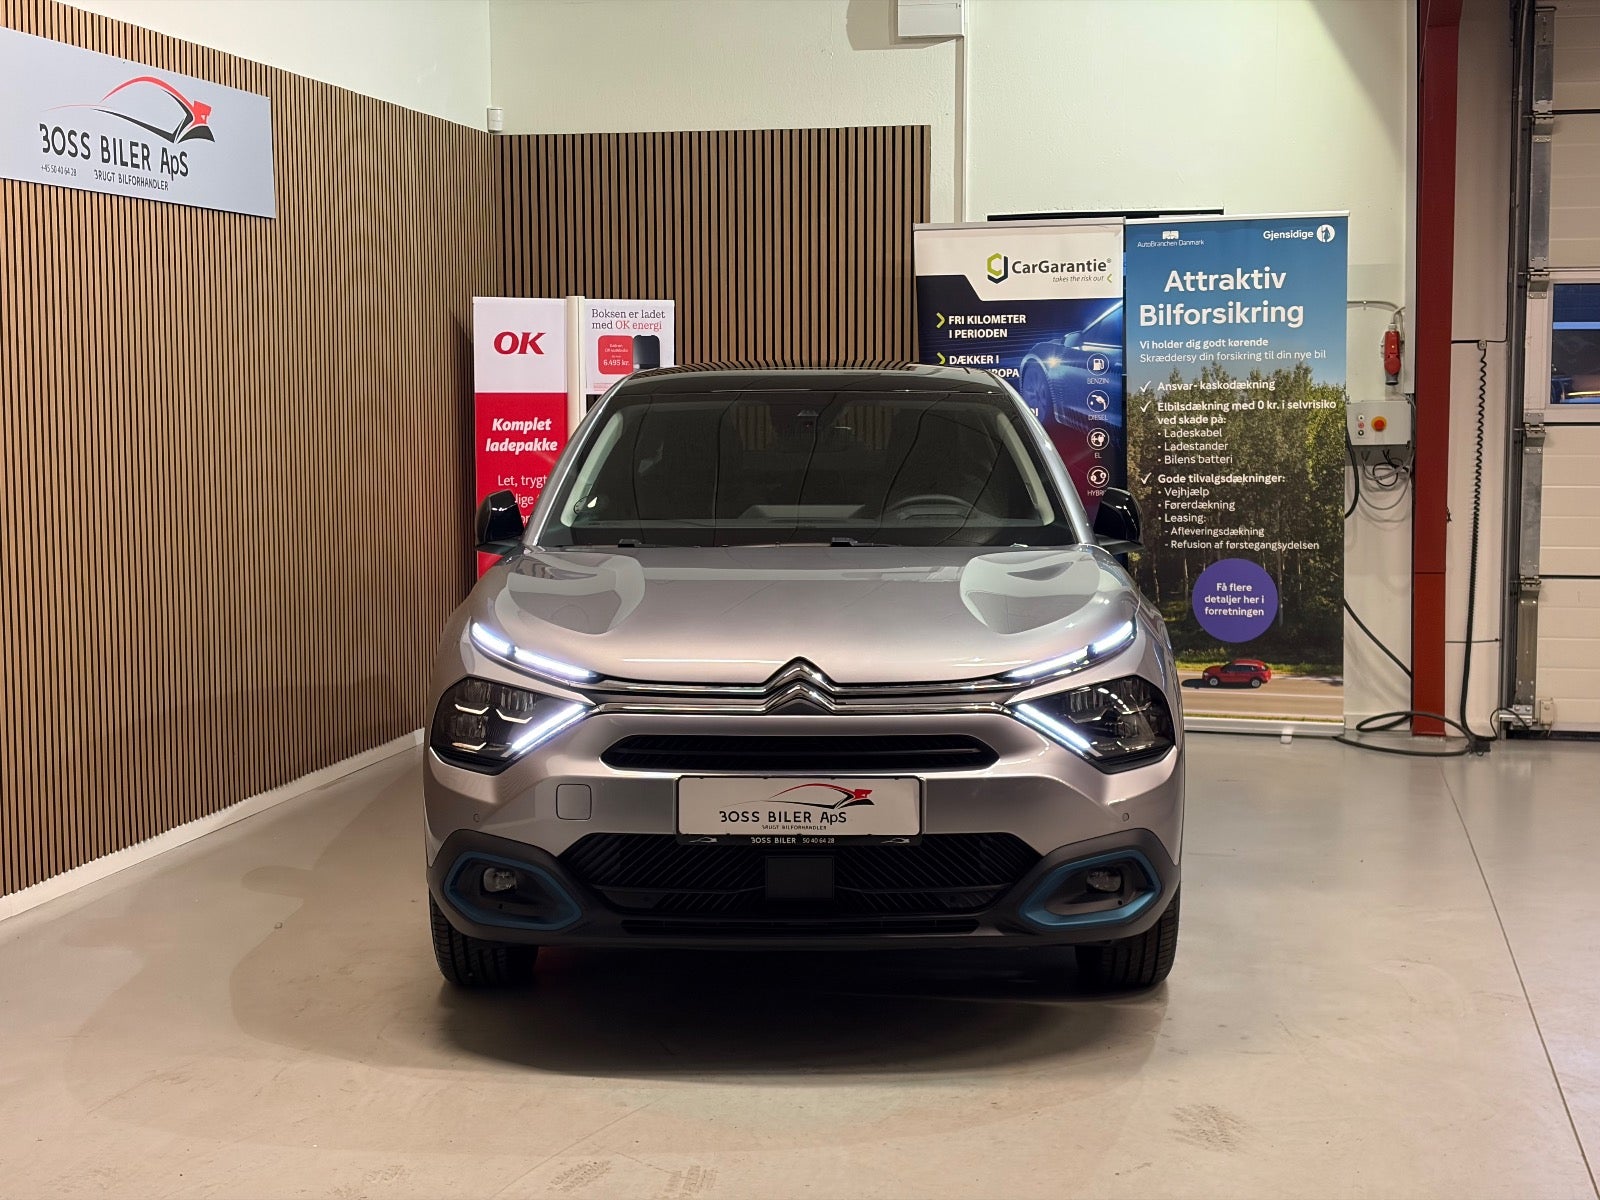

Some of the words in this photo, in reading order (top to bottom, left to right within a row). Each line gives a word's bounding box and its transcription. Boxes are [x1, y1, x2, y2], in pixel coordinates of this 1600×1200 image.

[100, 135, 152, 171] BILER
[160, 146, 189, 181] ApS
[118, 173, 169, 191] BILFORHANDLER
[1263, 229, 1314, 240] Gjensidige
[1164, 266, 1287, 292] Attraktiv
[592, 308, 626, 318] Boksen
[641, 310, 665, 319] ladet
[1140, 300, 1304, 328] Bilforsikring
[592, 320, 613, 329] med
[615, 321, 630, 329] OK
[632, 321, 662, 331] energi
[948, 315, 965, 326] FRI
[967, 314, 1026, 325] KILOMETER
[949, 330, 952, 338] I
[954, 328, 1008, 338] PERIODEN
[493, 331, 547, 355] OK
[1140, 340, 1149, 349] Vi
[1152, 339, 1183, 349] holder
[1185, 338, 1200, 351] dig
[1203, 338, 1226, 351] godt
[1228, 337, 1268, 347] kørende
[949, 355, 993, 365] DÆKKER
[996, 354, 999, 364] I
[1140, 353, 1196, 364] Skræddersy
[1199, 352, 1214, 361] din
[1216, 351, 1262, 363] forsikring
[1264, 351, 1274, 360] til
[1276, 350, 1292, 360] din
[1294, 352, 1312, 362] nye
[1314, 350, 1326, 359] bil
[1158, 382, 1198, 391] Ansvar-
[1200, 380, 1276, 391] kaskodækning
[1158, 401, 1230, 413] Elbilsdækning
[1232, 401, 1255, 410] med
[1257, 401, 1265, 410] 0
[1267, 401, 1280, 410] kr.
[1282, 401, 1286, 409] i
[1287, 400, 1336, 409] selvrisiko
[492, 416, 552, 434] Komplet
[1158, 416, 1176, 425] ved
[1178, 416, 1208, 425] skade
[1210, 414, 1227, 426] på:
[1164, 429, 1222, 438] Ladeskabel
[485, 438, 558, 455] ladepakke
[1164, 442, 1228, 451] Ladestander
[1164, 455, 1196, 464] Bilens
[1198, 455, 1233, 464] batteri
[498, 475, 518, 487] Let,
[521, 475, 547, 488] trygt
[1158, 474, 1186, 483] Gode
[1188, 474, 1286, 485] tilvalgsdækninger:
[1164, 488, 1209, 497] Vejhjælp
[1164, 500, 1235, 512] Førerdækning
[1164, 514, 1206, 524] Leasing:
[1170, 527, 1264, 537] Afleveringsdækning
[1171, 540, 1211, 549] Refusion
[1214, 541, 1223, 549] af
[1225, 541, 1319, 551] førstegangsydelsen
[1216, 582, 1227, 592] Få
[1230, 583, 1252, 591] flere
[1204, 595, 1242, 606] detaljer
[1243, 595, 1260, 604] her
[1262, 595, 1264, 604] i
[1204, 607, 1264, 616] forretningen
[768, 811, 812, 823] BILER
[820, 811, 847, 825] ApS
